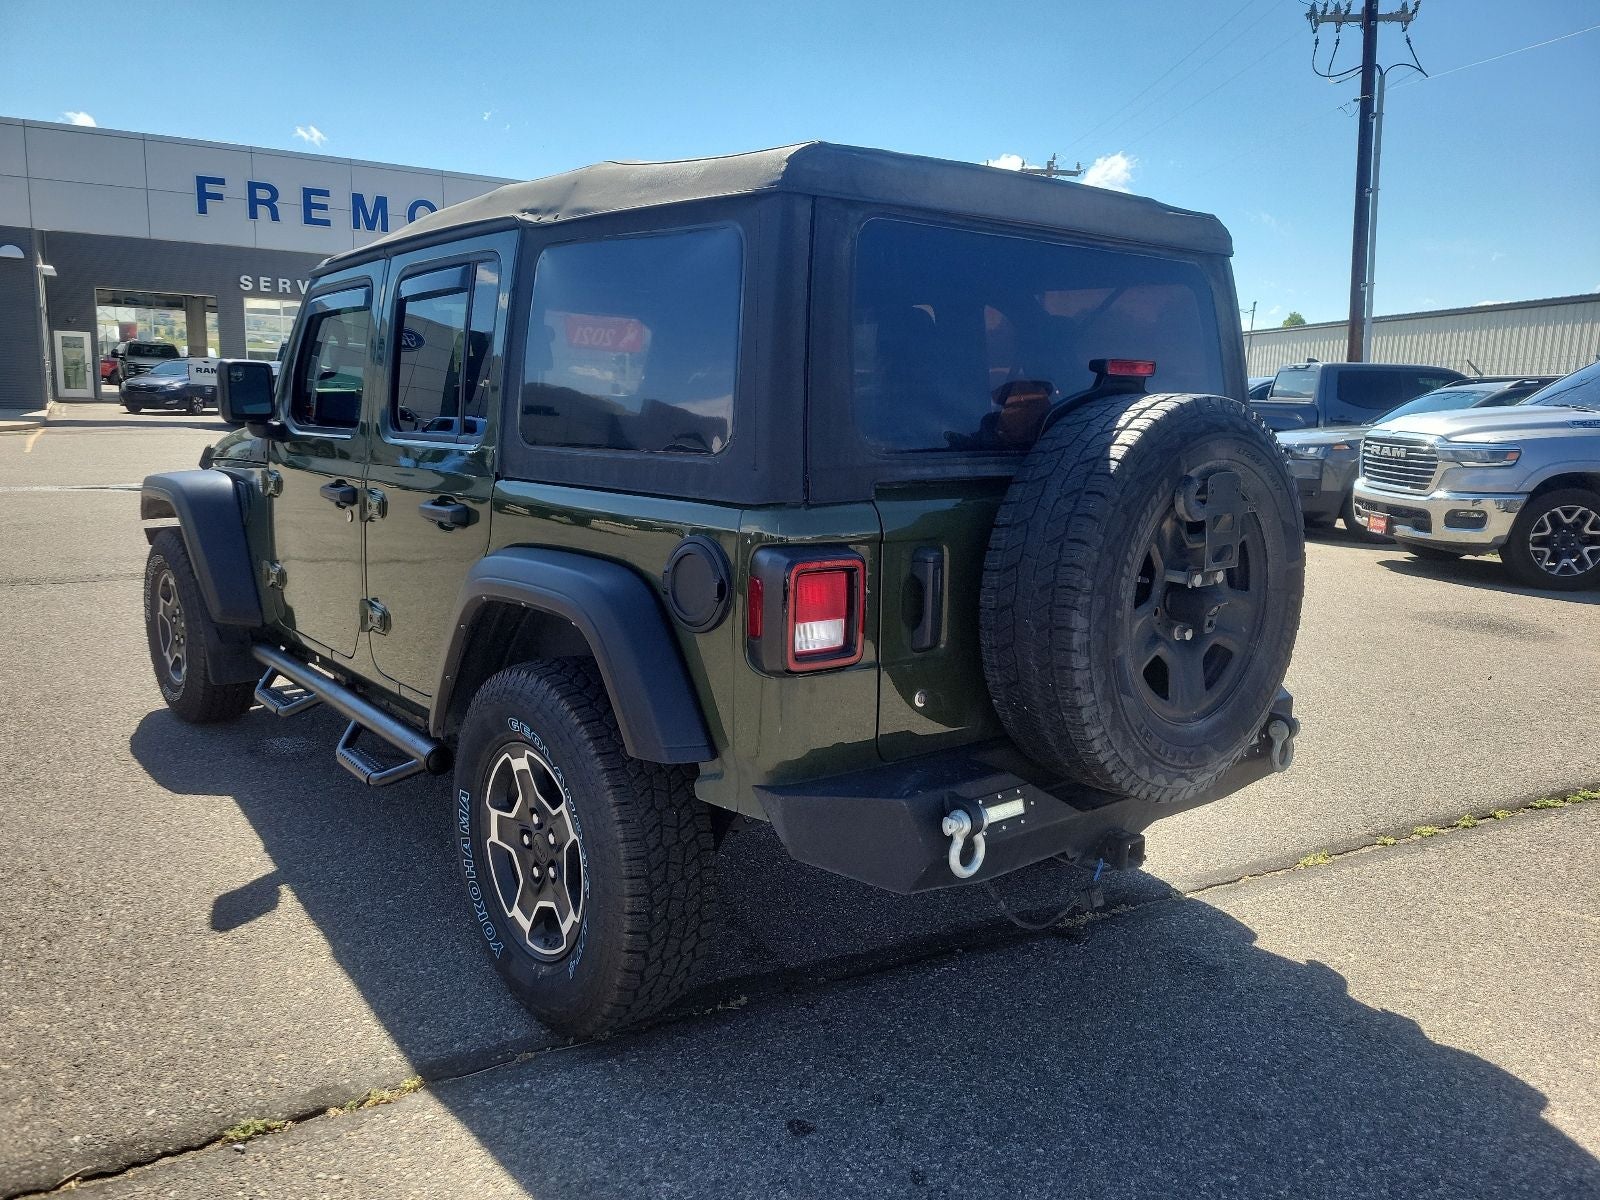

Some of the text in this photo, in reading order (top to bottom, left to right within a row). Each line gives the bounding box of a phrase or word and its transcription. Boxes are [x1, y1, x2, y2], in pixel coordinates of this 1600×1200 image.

[239, 274, 311, 295] SERV
[1370, 445, 1407, 459] RAM
[456, 788, 505, 960] YOKOHAMA
